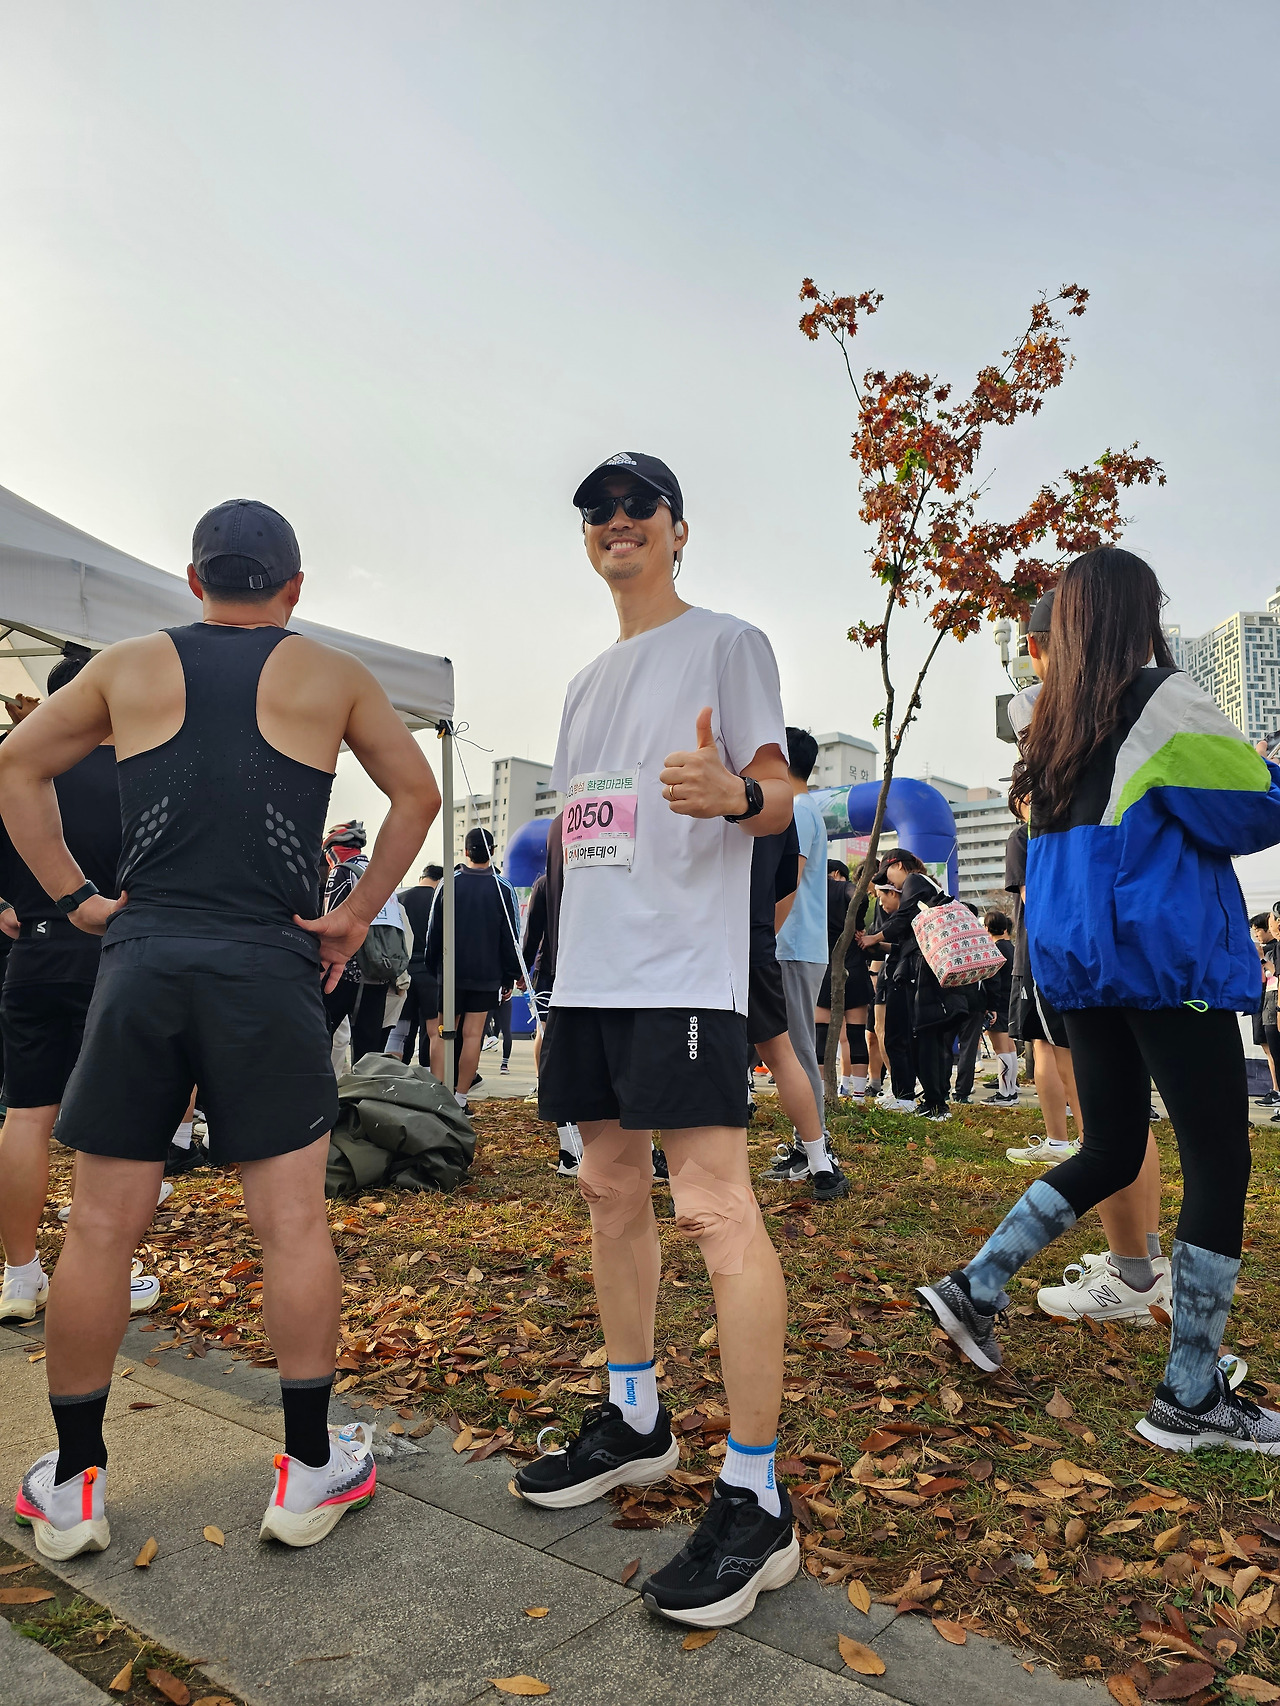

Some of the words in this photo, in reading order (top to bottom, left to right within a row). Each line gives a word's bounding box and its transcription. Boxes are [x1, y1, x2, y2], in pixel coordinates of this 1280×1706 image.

[587, 777, 633, 791] 환경마라톤
[567, 800, 614, 833] 2050
[568, 845, 617, 862] 아시아투데이
[687, 1015, 698, 1060] adidas
